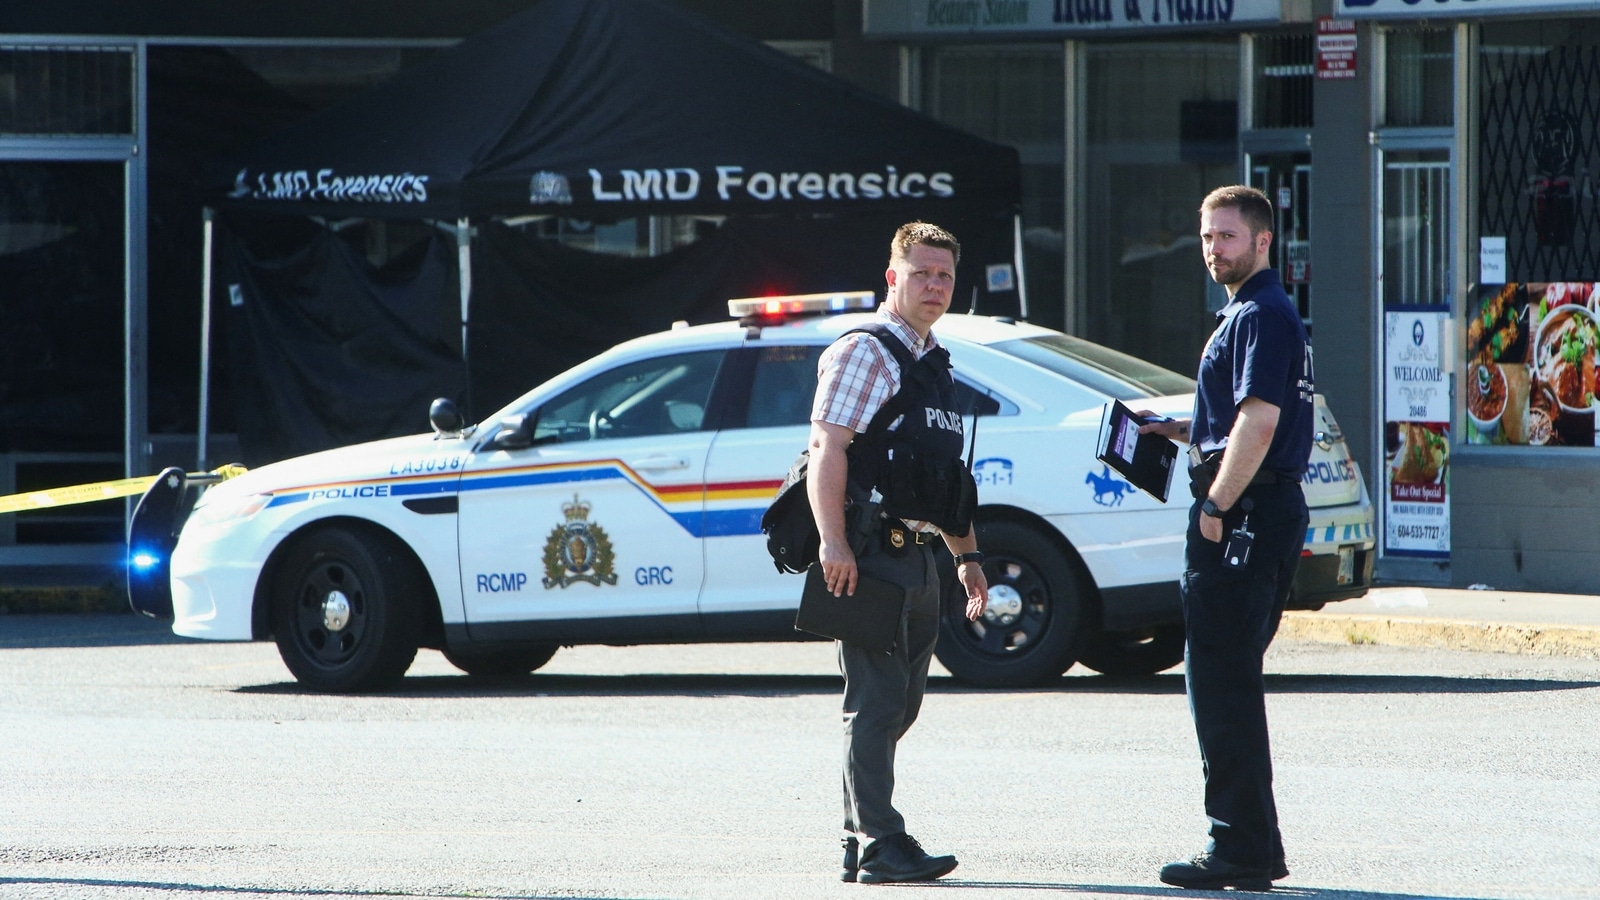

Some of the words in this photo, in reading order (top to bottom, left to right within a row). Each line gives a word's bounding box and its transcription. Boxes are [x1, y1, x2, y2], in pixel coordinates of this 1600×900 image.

[588, 168, 700, 201] LMD
[715, 165, 955, 200] Forensics
[1394, 366, 1442, 382] WELCOME
[925, 407, 962, 434] POLICE
[975, 472, 1013, 485] 9-1-1
[312, 485, 389, 500] POLICE
[1395, 485, 1408, 497] Take
[1410, 486, 1421, 498] Out
[1422, 485, 1442, 501] Special
[476, 573, 527, 593] RCMP
[635, 566, 673, 586] GRC
